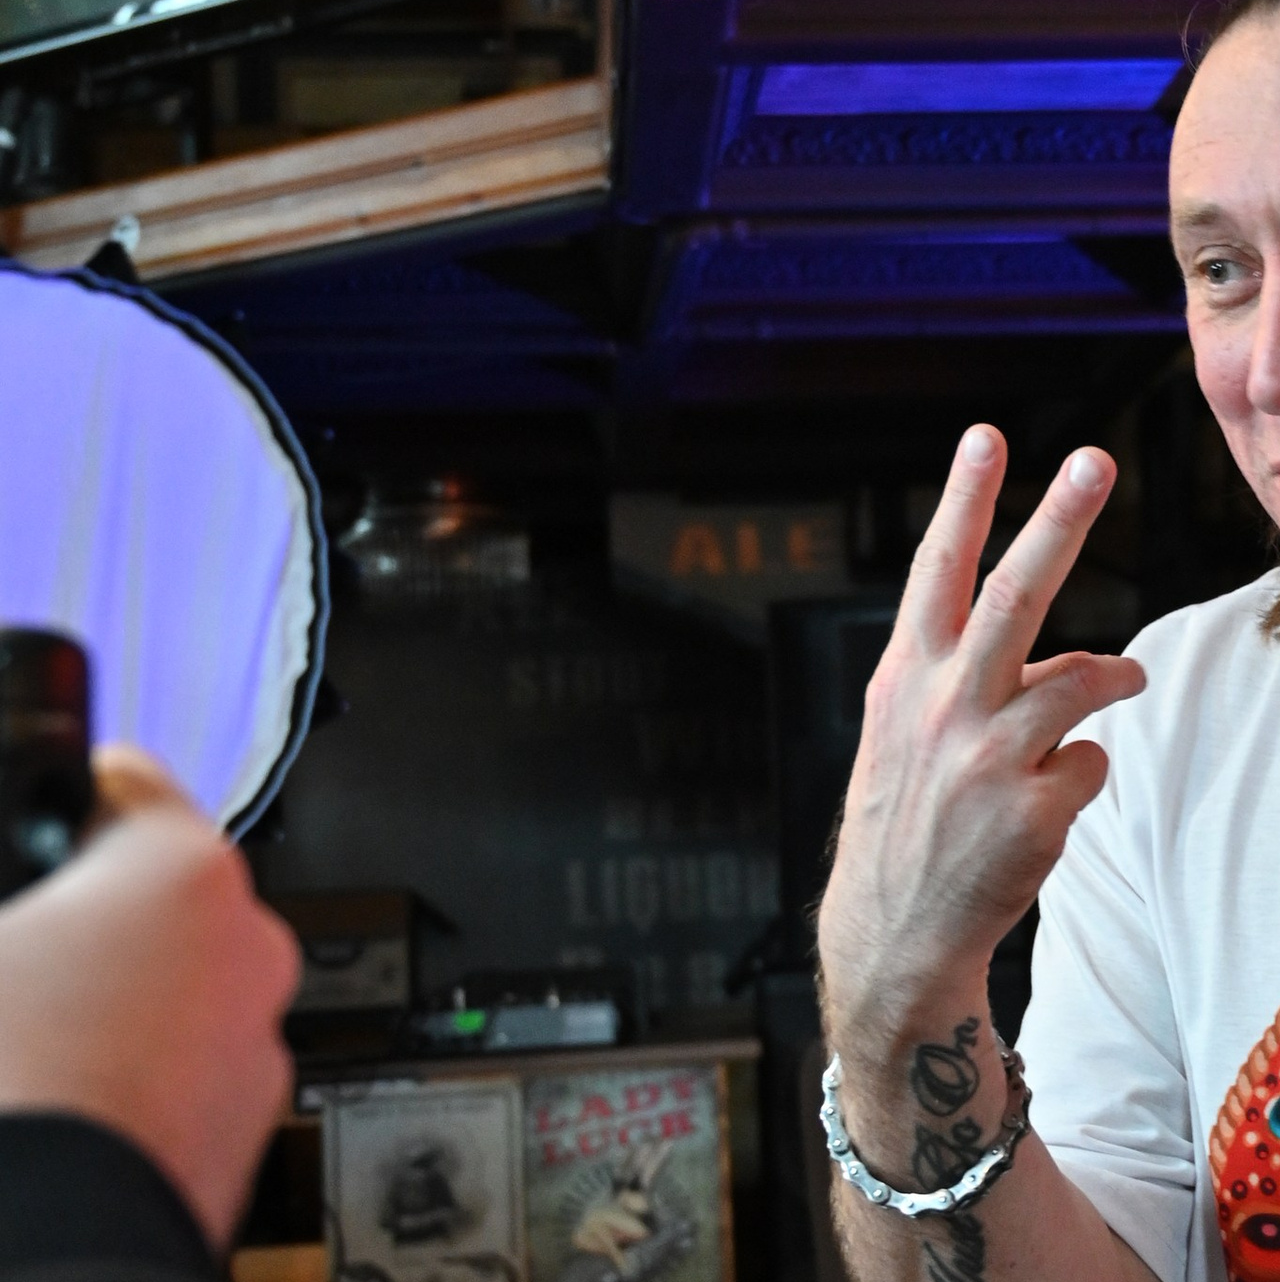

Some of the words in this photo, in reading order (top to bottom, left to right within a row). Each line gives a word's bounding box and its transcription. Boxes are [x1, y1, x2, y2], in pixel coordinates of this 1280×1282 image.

[668, 520, 836, 576] ALE
[910, 1016, 980, 1116] On
[535, 1076, 698, 1135] LADY
[542, 1109, 696, 1166] LUCK
